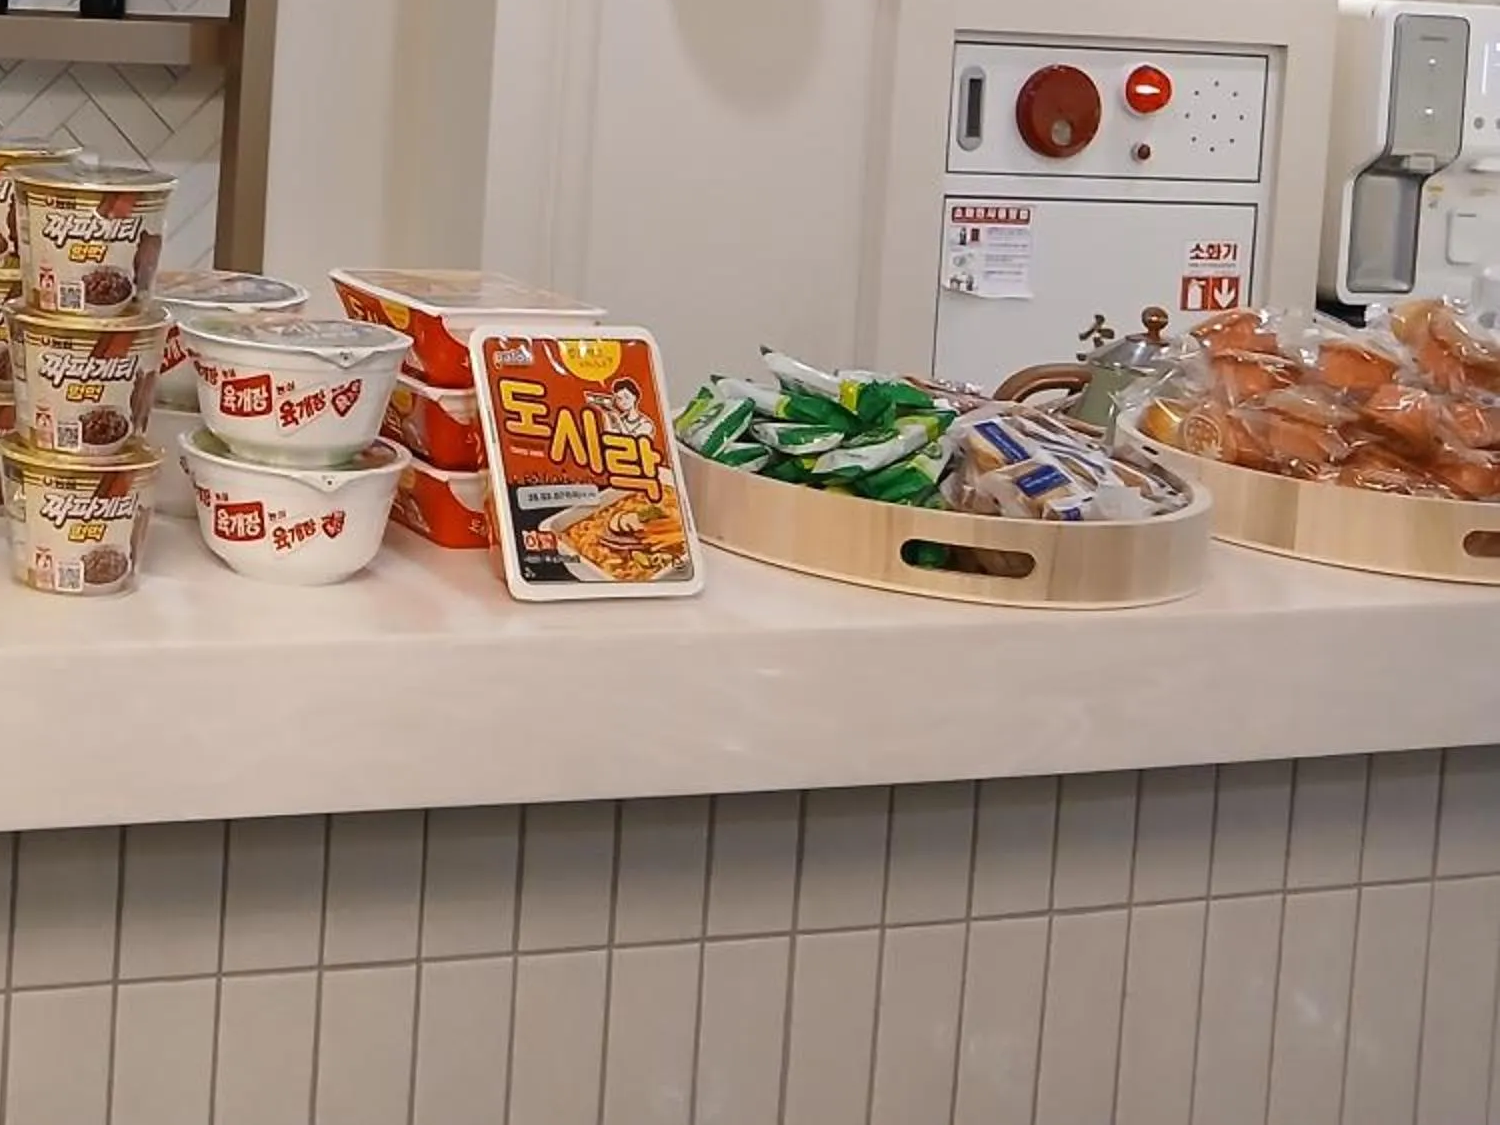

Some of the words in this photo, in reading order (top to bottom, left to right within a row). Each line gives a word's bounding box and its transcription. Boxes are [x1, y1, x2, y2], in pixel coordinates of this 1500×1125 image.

[43, 213, 142, 247] 짜파게티
[1189, 242, 1238, 261] 소화기
[40, 353, 139, 388] 짜파게티
[223, 385, 268, 412] 육개장
[499, 378, 663, 503] 도시락
[41, 492, 138, 528] 짜파게티
[217, 509, 261, 538] 육개장
